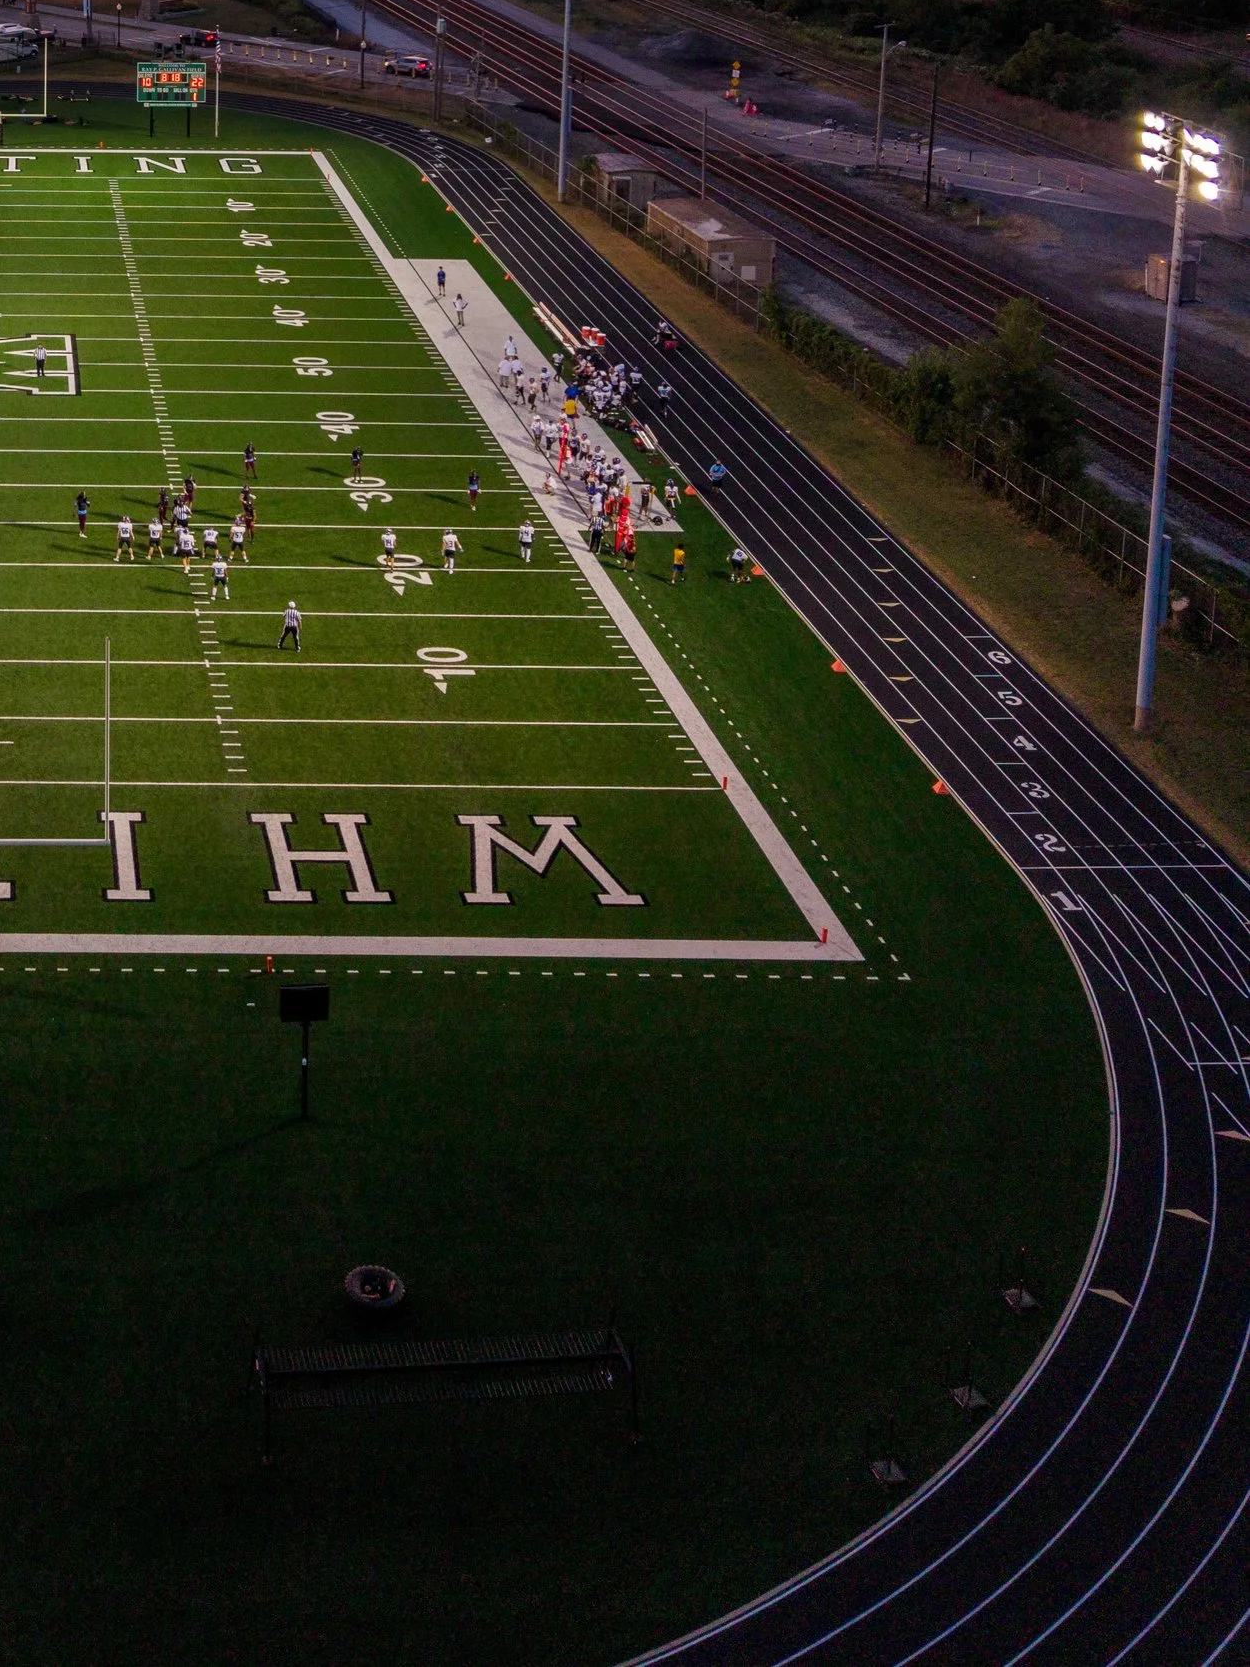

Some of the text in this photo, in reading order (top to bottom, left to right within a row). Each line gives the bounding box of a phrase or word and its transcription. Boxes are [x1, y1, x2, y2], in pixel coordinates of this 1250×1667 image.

[142, 77, 152, 87] 10
[191, 77, 204, 87] 22
[226, 201, 256, 212] 10
[239, 233, 273, 247] 20
[255, 269, 290, 284] 30
[272, 309, 310, 327] 40
[292, 356, 334, 377] 50
[315, 411, 360, 434] 40
[343, 476, 393, 503] 30
[376, 553, 433, 585] 20
[416, 646, 476, 680] 10
[987, 650, 1012, 665] 6
[997, 691, 1023, 706] 5
[1013, 735, 1037, 751] 4
[1021, 782, 1051, 799] 3
[1035, 833, 1066, 852] 2
[1051, 890, 1083, 911] 1
